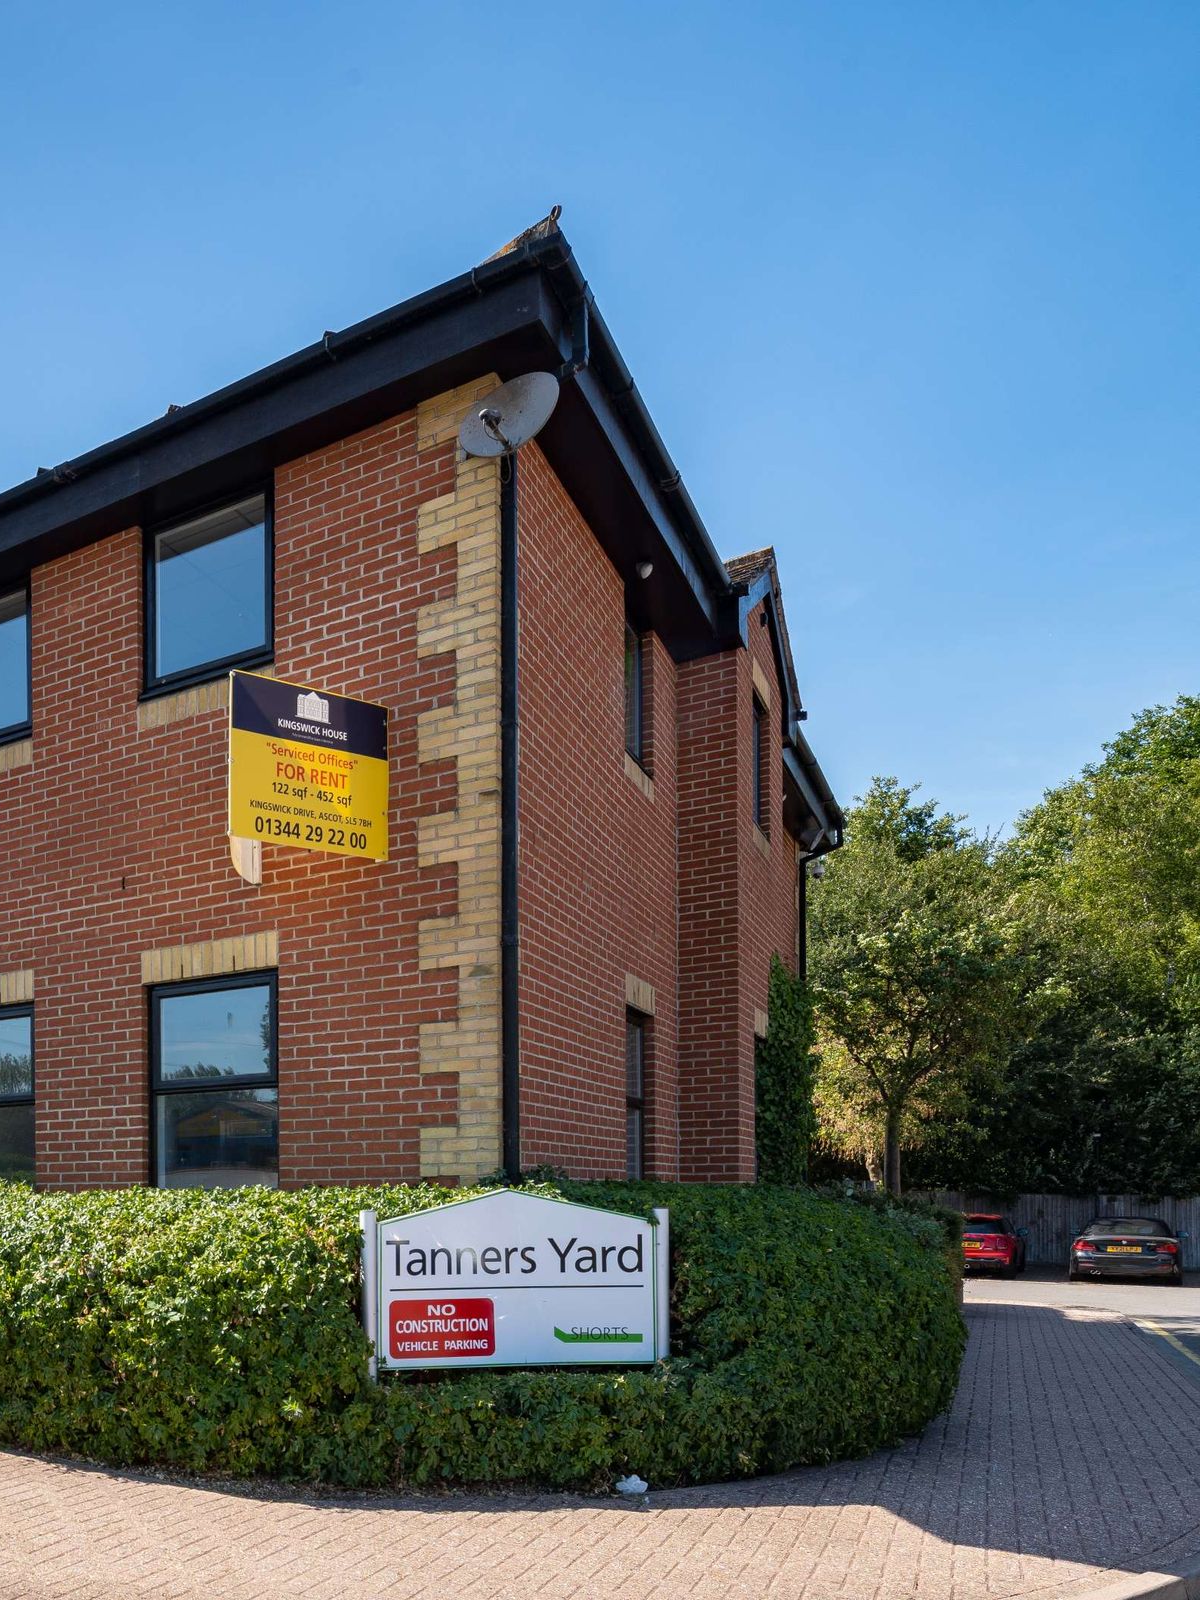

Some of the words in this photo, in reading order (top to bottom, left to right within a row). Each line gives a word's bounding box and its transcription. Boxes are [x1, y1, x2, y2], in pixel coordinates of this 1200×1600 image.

[277, 718, 320, 735] KINGSWICK
[322, 727, 348, 741] HOUSE
[276, 761, 305, 782] FOR
[310, 768, 348, 790] RENT
[272, 781, 289, 796] 122
[292, 786, 308, 801] sqf
[316, 789, 334, 803] 452
[337, 795, 352, 808] sqf
[249, 799, 291, 815] KINGSWICK
[293, 807, 317, 820] DRIVE,
[318, 811, 344, 825] ASCOT,
[345, 816, 357, 826] SL5
[254, 816, 301, 839] 01344
[305, 824, 323, 843] 29
[327, 828, 345, 846] 22
[349, 832, 367, 850] 00
[386, 1240, 537, 1277] Tanners
[547, 1234, 643, 1274] Yard
[427, 1304, 456, 1316] NO
[396, 1318, 489, 1334] CONSTRUCTION
[571, 1326, 629, 1341] SHORTS
[397, 1340, 438, 1352] VEHICLE
[444, 1339, 489, 1351] PARKING
